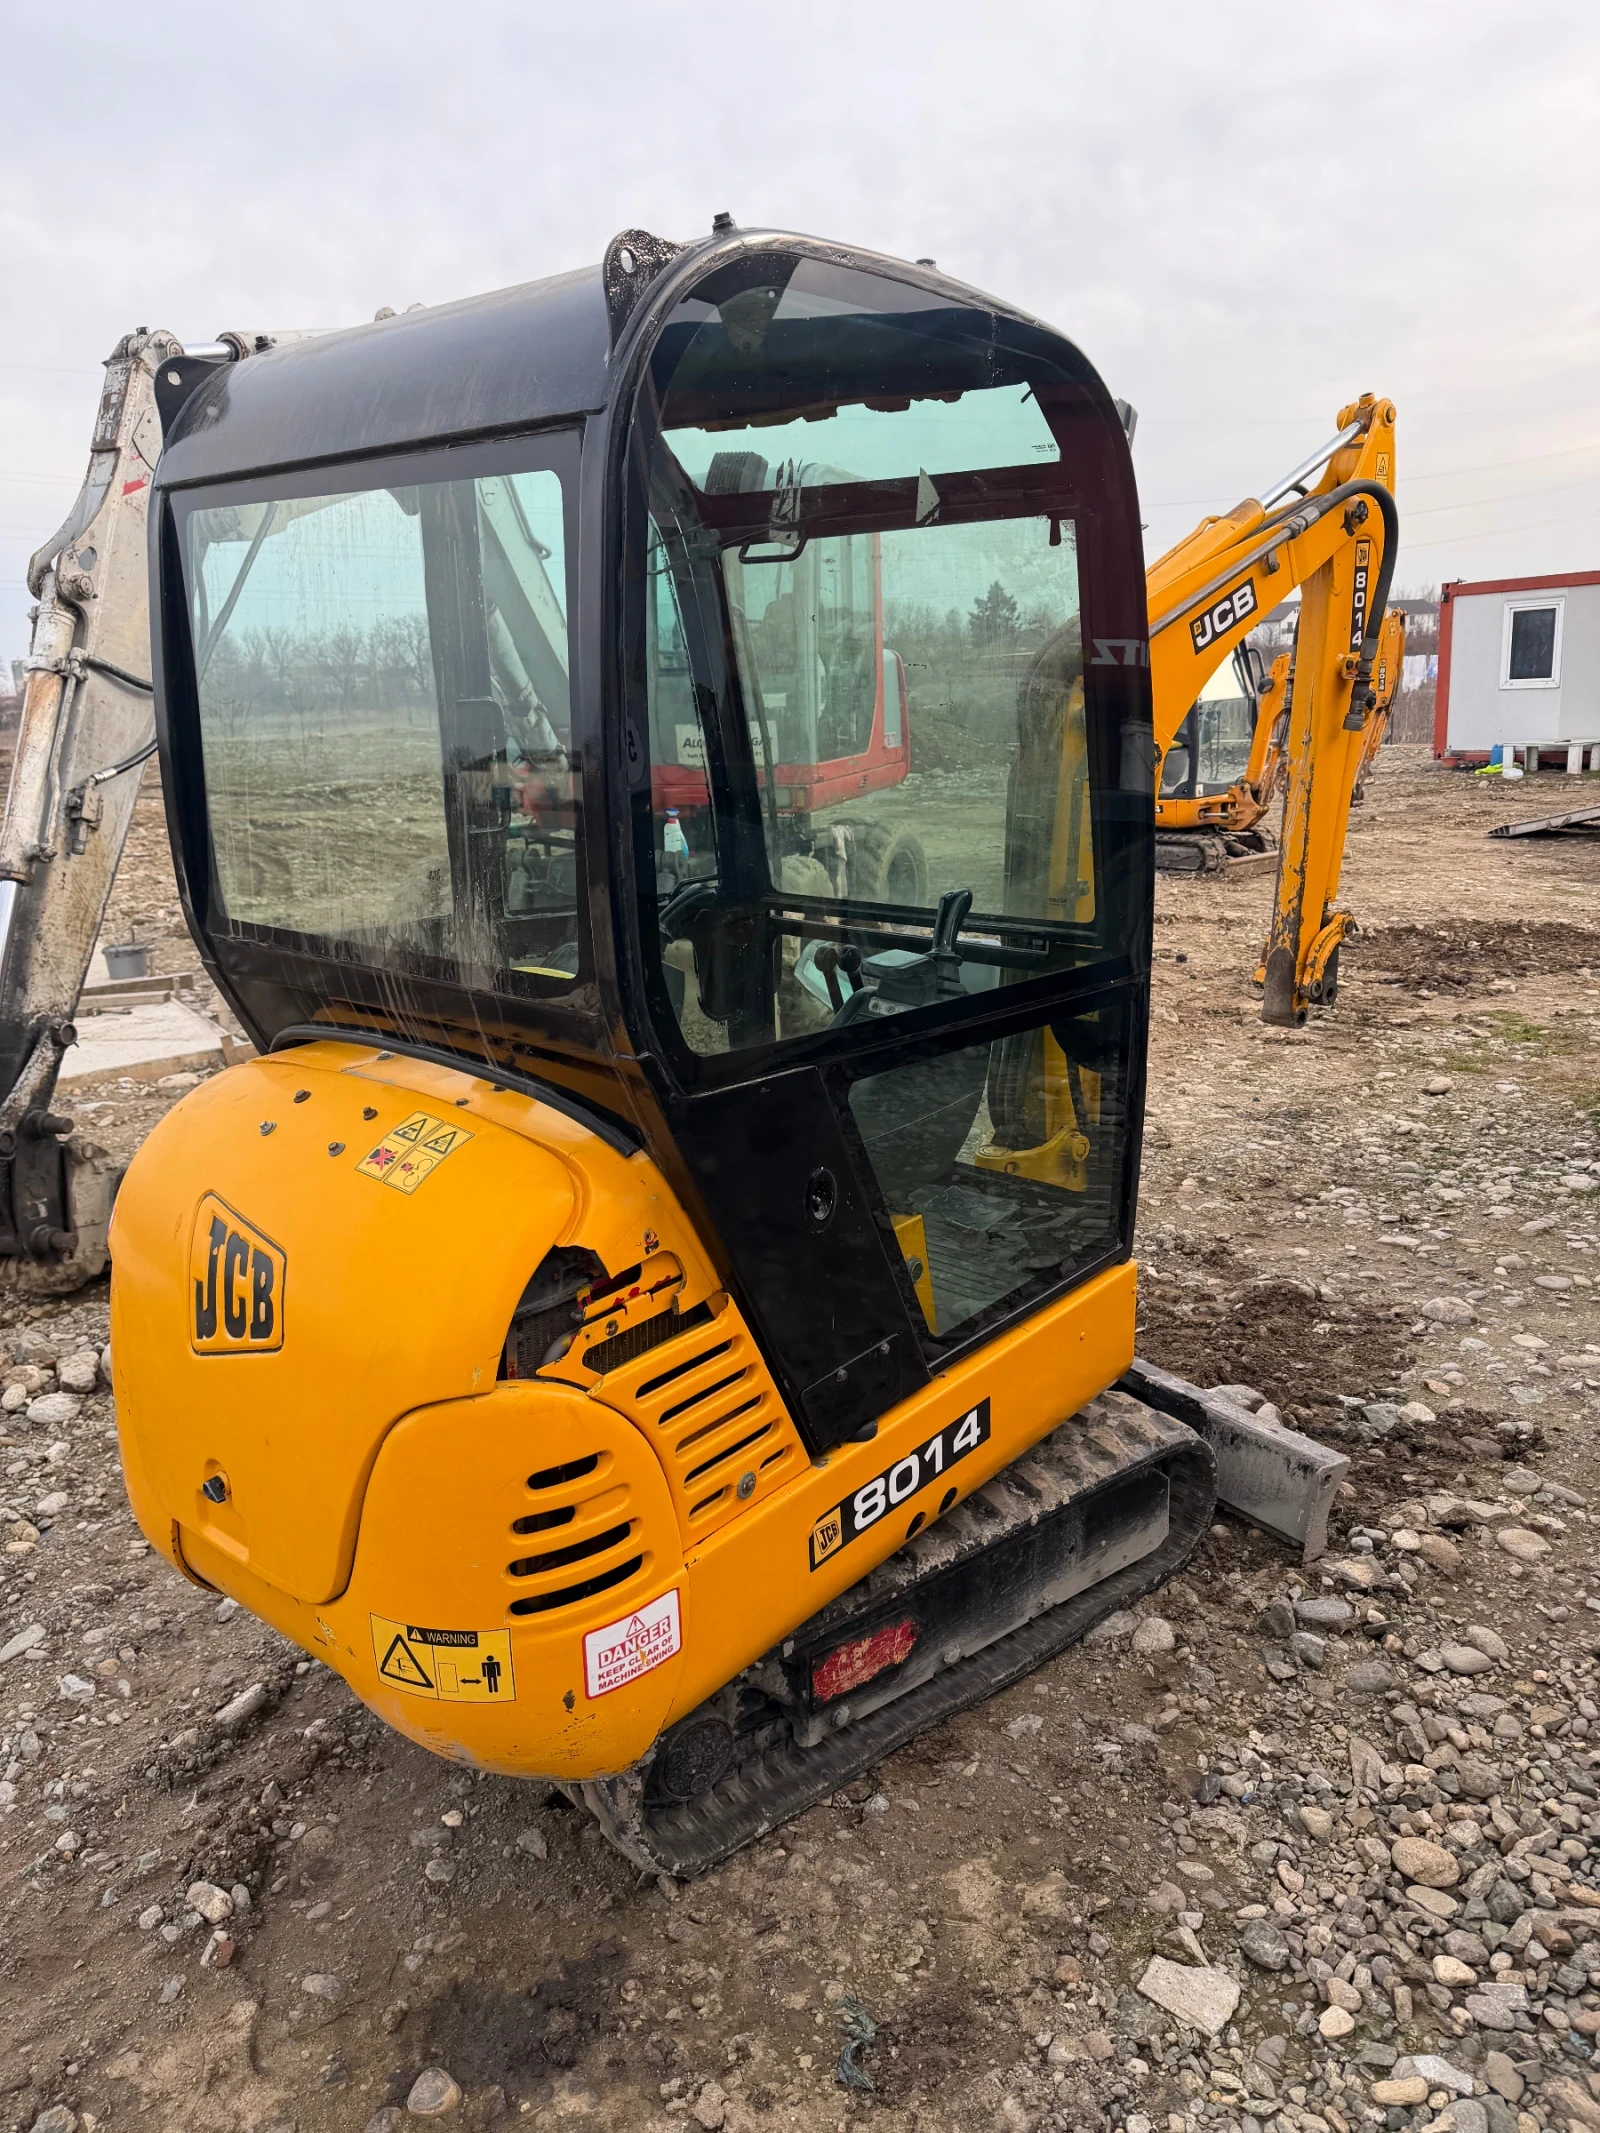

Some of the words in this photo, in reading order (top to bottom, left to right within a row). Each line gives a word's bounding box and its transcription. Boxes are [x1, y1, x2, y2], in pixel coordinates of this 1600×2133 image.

[1196, 585, 1254, 646] JCB
[1352, 572, 1366, 646] 8014
[196, 1216, 274, 1339] JCB
[817, 1525, 838, 1550] JCB
[853, 1409, 981, 1530] 8014
[426, 1631, 476, 1645] WARNING
[598, 1663, 625, 1681] KEEP
[662, 1635, 673, 1646] OF
[600, 1616, 670, 1668] DANGER
[599, 1664, 643, 1691] MACHINE
